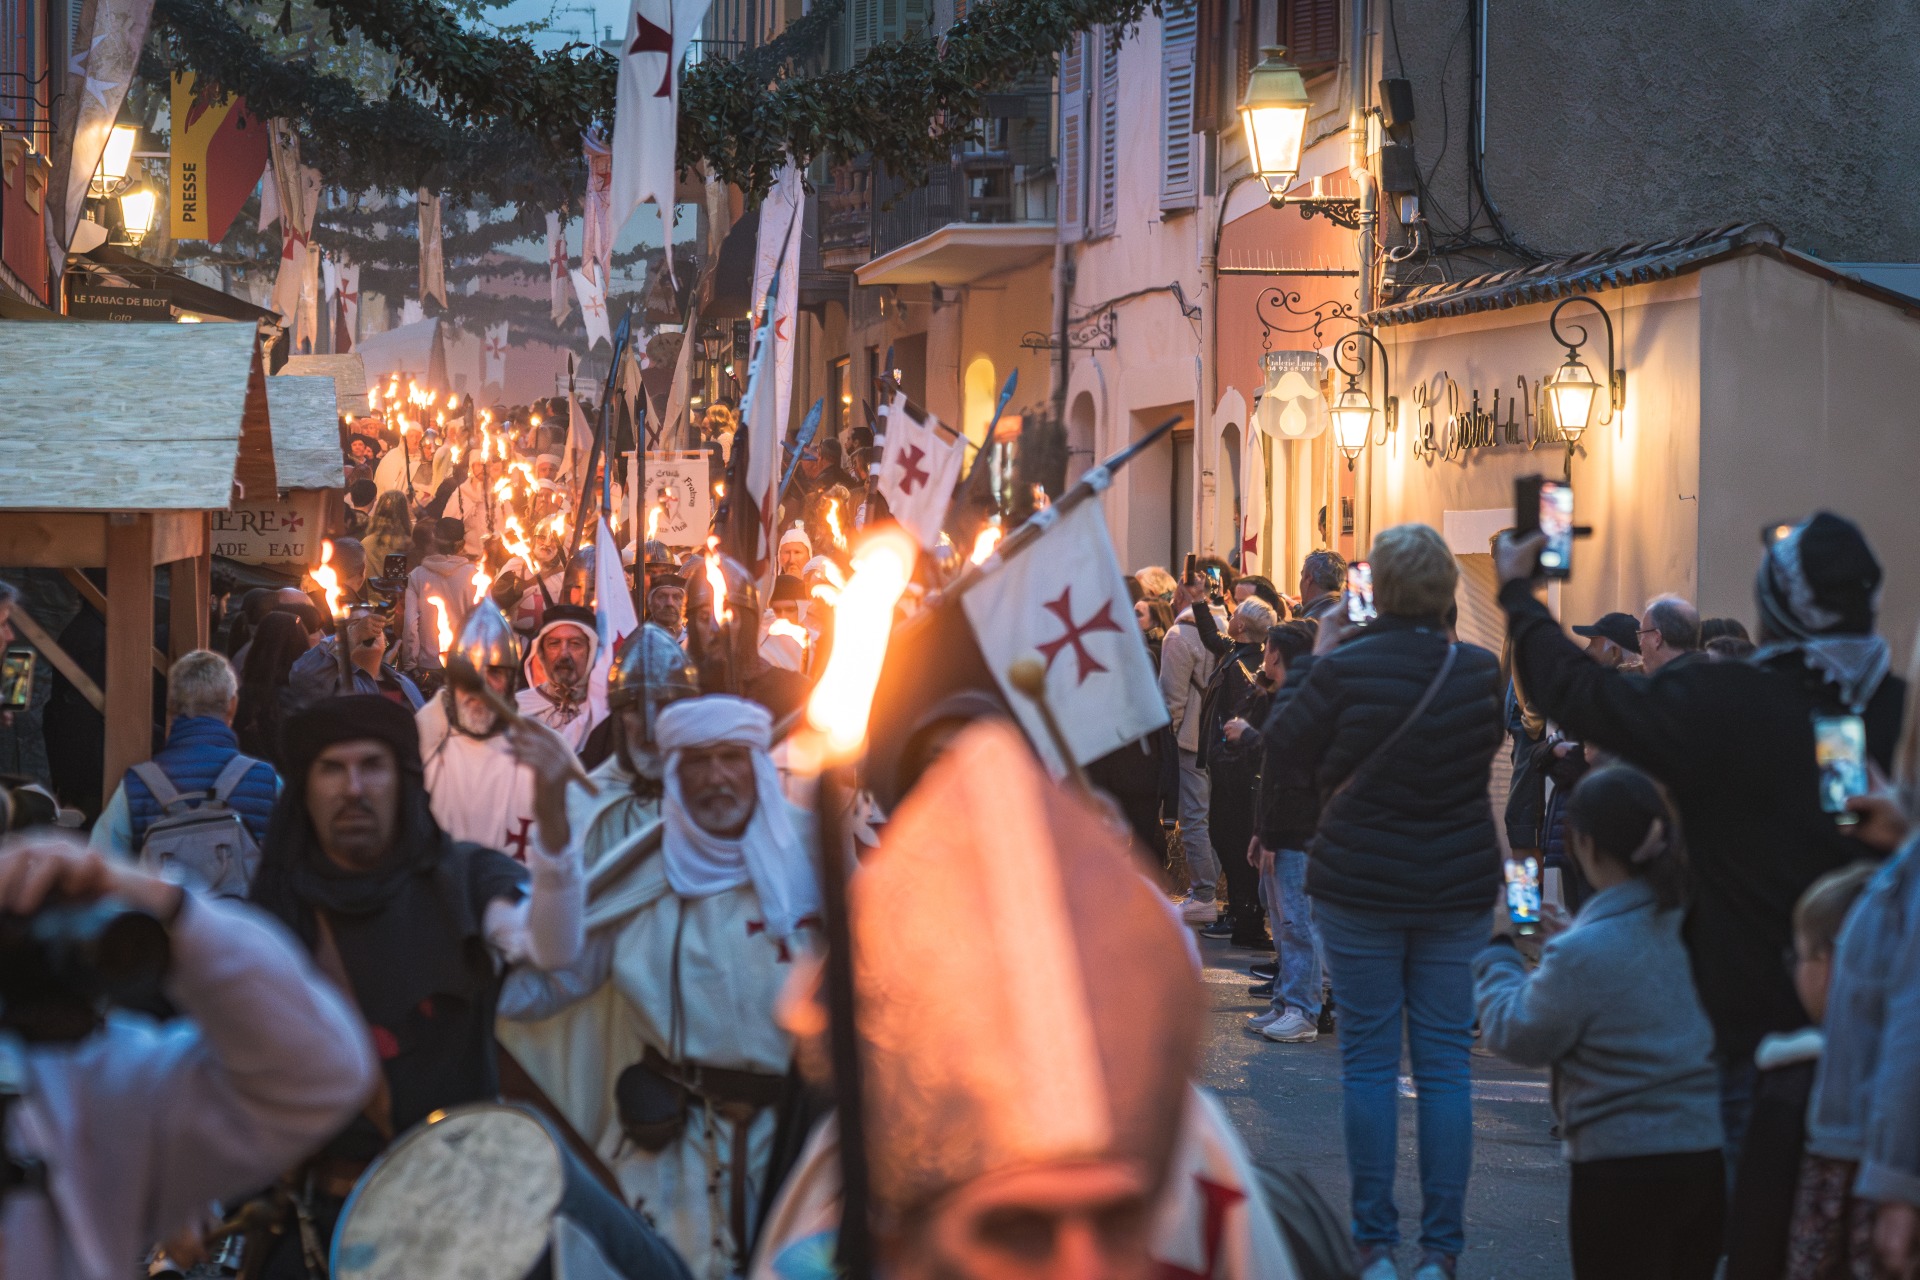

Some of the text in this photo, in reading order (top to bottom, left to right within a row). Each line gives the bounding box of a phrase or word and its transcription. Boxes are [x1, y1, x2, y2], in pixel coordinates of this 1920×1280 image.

[182, 163, 197, 222] PRESSE
[74, 295, 87, 303] LE
[89, 296, 124, 306] TABAC
[126, 297, 141, 306] DE
[1267, 355, 1296, 367] Galerie
[1412, 379, 1437, 460] Le
[1442, 371, 1499, 461] Bistrot
[268, 544, 304, 556] EAU
